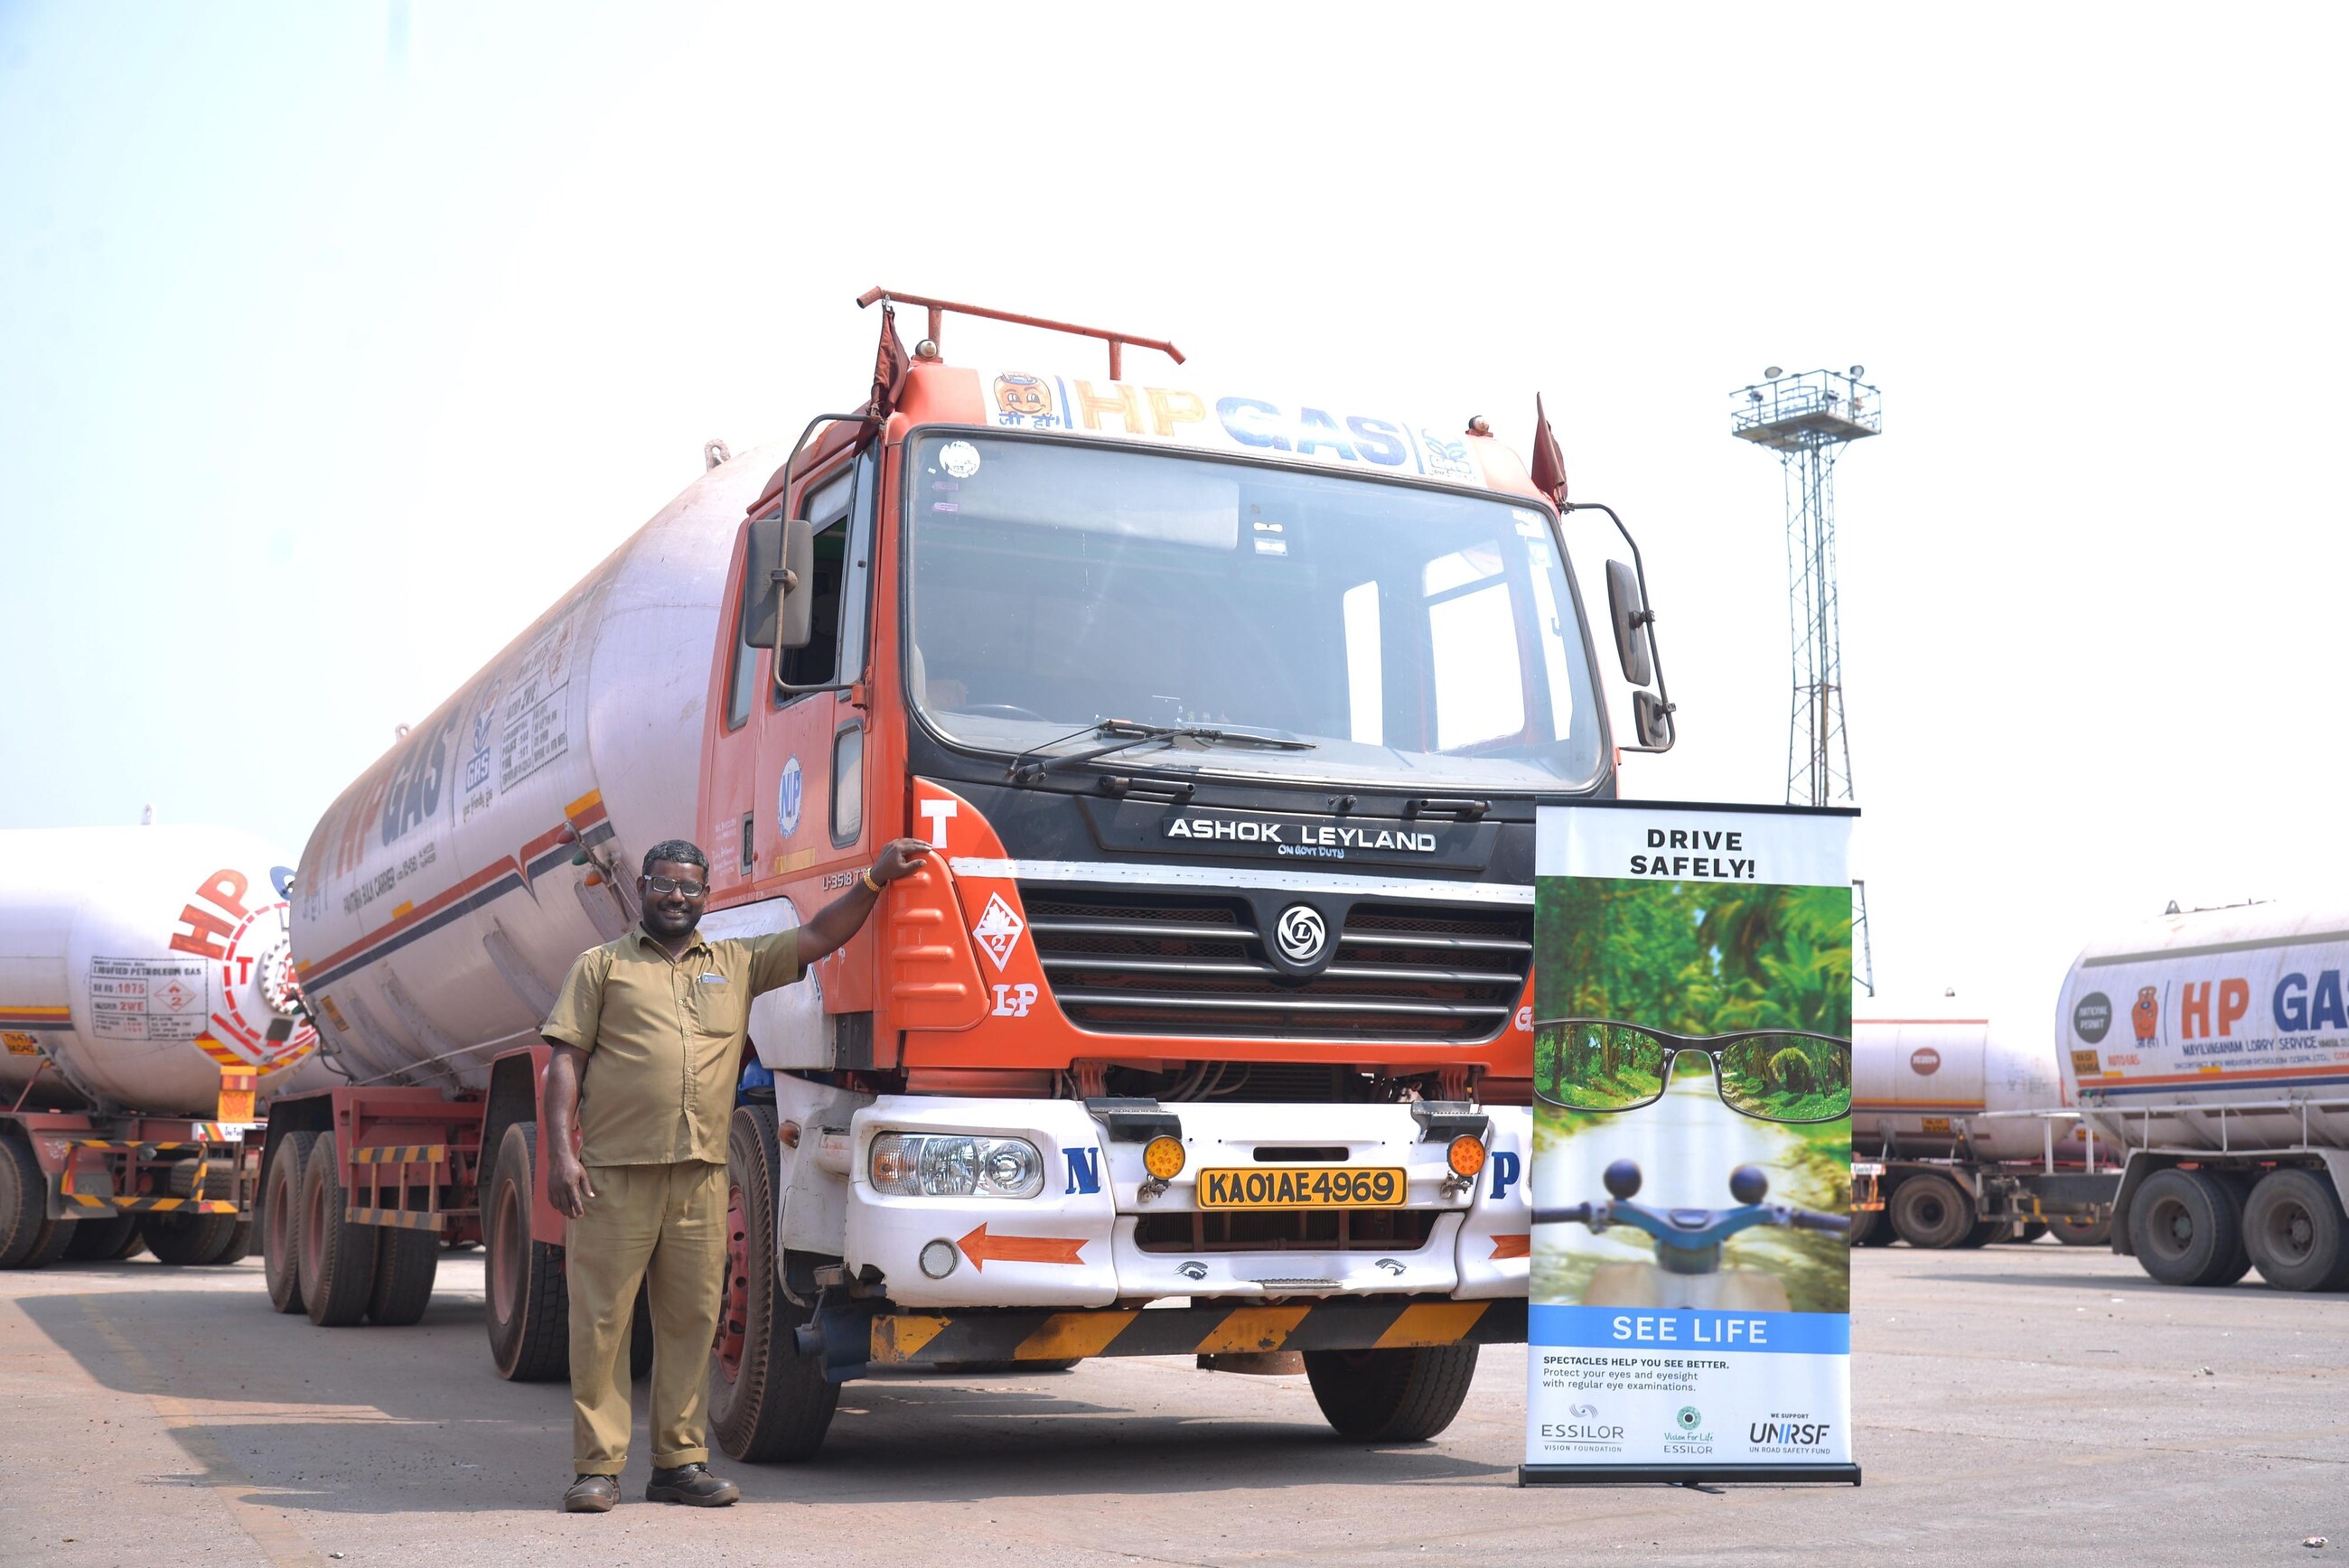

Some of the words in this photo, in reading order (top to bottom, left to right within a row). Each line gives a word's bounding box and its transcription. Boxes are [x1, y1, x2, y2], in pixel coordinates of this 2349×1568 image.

[1073, 379, 1207, 436] HP
[1215, 396, 1408, 467] GAS
[381, 705, 463, 847] GAS
[467, 753, 489, 792] GAS
[921, 799, 958, 848] T
[1168, 819, 1282, 842] ASHOK
[1302, 826, 1437, 852] LEYLAND
[1277, 845, 1294, 855] ON
[1319, 848, 1344, 859] DUTY
[1647, 829, 1742, 851] DRIVE
[1630, 855, 1755, 879] SAFELY!
[169, 869, 250, 961] HP
[992, 935, 1006, 952] 2
[1296, 923, 1310, 939] L
[236, 957, 254, 985] T
[172, 996, 182, 1006] 2
[991, 984, 1039, 1018] LP
[2182, 977, 2250, 1039] HP
[2273, 969, 2349, 1032] GA
[1515, 1005, 1534, 1031] G
[2246, 1039, 2275, 1052] LORRY
[2279, 1036, 2318, 1050] SERVICE
[1062, 1147, 1100, 1195] N
[1490, 1151, 1521, 1199] P
[1209, 1171, 1395, 1204] KA01AE4969
[1613, 1316, 1677, 1341] SEE
[1694, 1318, 1767, 1344] LIFE
[1543, 1356, 1608, 1367] SPECTACLES
[1611, 1358, 1637, 1367] HELP
[1640, 1358, 1661, 1367] YOU
[1664, 1359, 1684, 1368] SEE
[1687, 1360, 1730, 1369] BETTER.
[1543, 1367, 1580, 1378] Protect
[1583, 1370, 1605, 1381] your
[1608, 1371, 1631, 1380] eyes
[1634, 1370, 1653, 1380] and
[1656, 1371, 1699, 1382] eyesight
[1542, 1379, 1565, 1389] with
[1568, 1380, 1604, 1391] regular
[1606, 1383, 1624, 1391] eye
[1627, 1382, 1697, 1392] examinations.
[1541, 1423, 1624, 1440] ESSILOR
[1664, 1433, 1687, 1442] Vision
[1688, 1433, 1699, 1441] For
[1700, 1433, 1714, 1442] Life
[1663, 1444, 1713, 1454] ESSILOR
